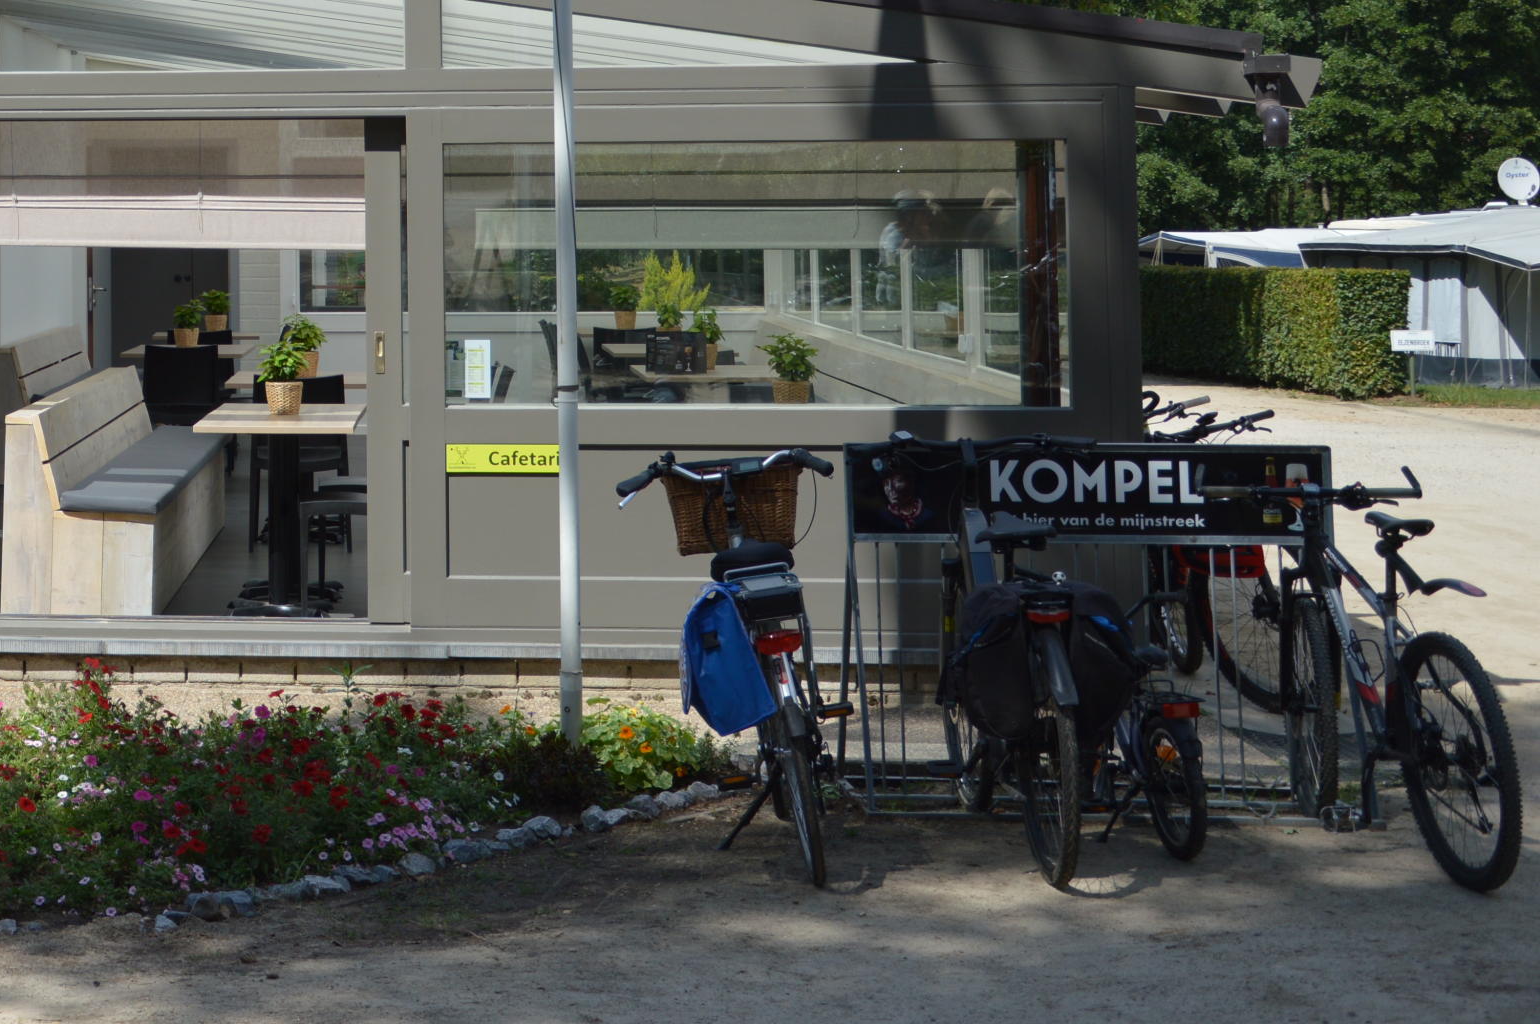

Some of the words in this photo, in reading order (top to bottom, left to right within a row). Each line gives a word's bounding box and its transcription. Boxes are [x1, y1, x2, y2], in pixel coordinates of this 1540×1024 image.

[488, 450, 560, 466] Cafetari
[989, 458, 1204, 504] KOMPEL
[1060, 516, 1090, 527] van
[1095, 513, 1116, 526] de
[1120, 513, 1205, 530] mijnstreek
